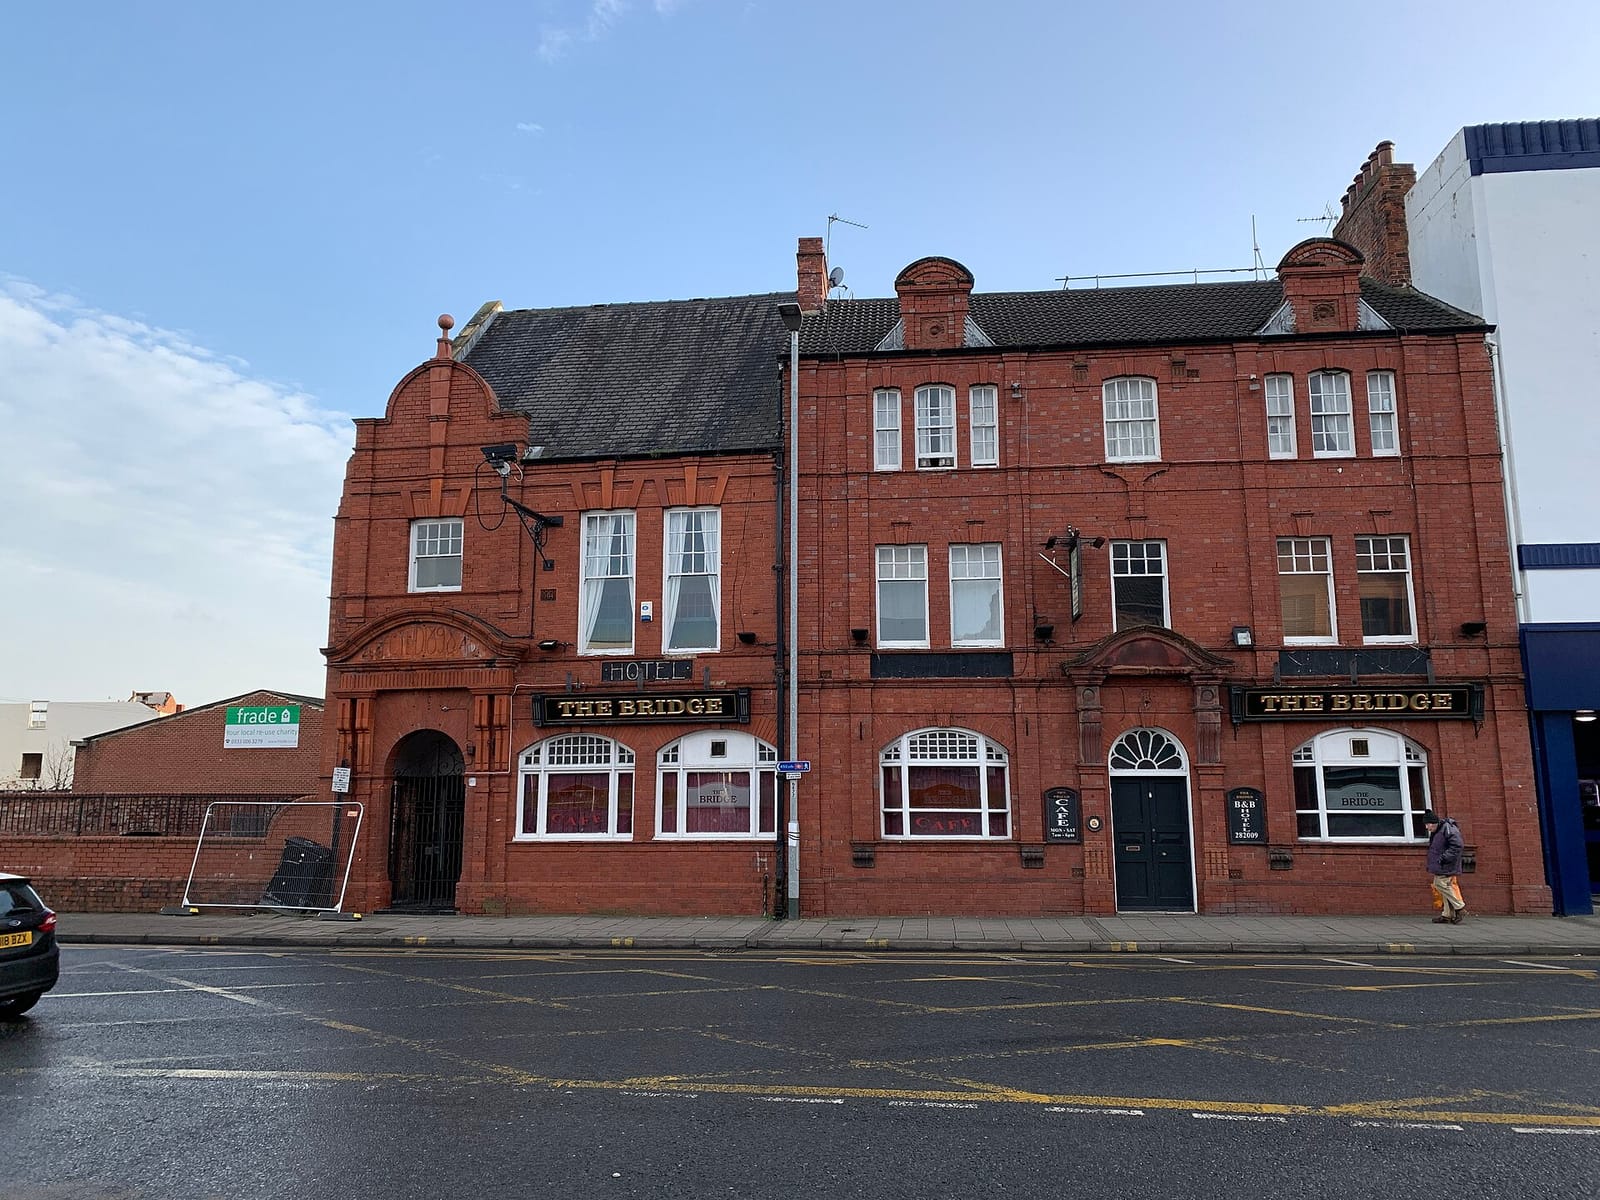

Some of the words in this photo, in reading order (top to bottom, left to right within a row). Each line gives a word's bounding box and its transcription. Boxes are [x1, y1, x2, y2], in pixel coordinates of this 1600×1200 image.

[610, 661, 685, 681] HOTEL
[557, 700, 613, 717] THE
[618, 698, 723, 715] BRIDGE
[1260, 694, 1324, 712] THE
[1331, 692, 1453, 711] BRIDGE
[237, 707, 277, 724] frade
[277, 728, 297, 737] charity
[699, 795, 738, 804] BRIDGE
[1234, 800, 1256, 809] B&B
[1341, 797, 1385, 806] BRIDGE
[1055, 798, 1069, 827] CAFE
[1240, 808, 1251, 832] HOTEL
[1234, 831, 1259, 839] 282009
[12, 934, 27, 944] BZX
